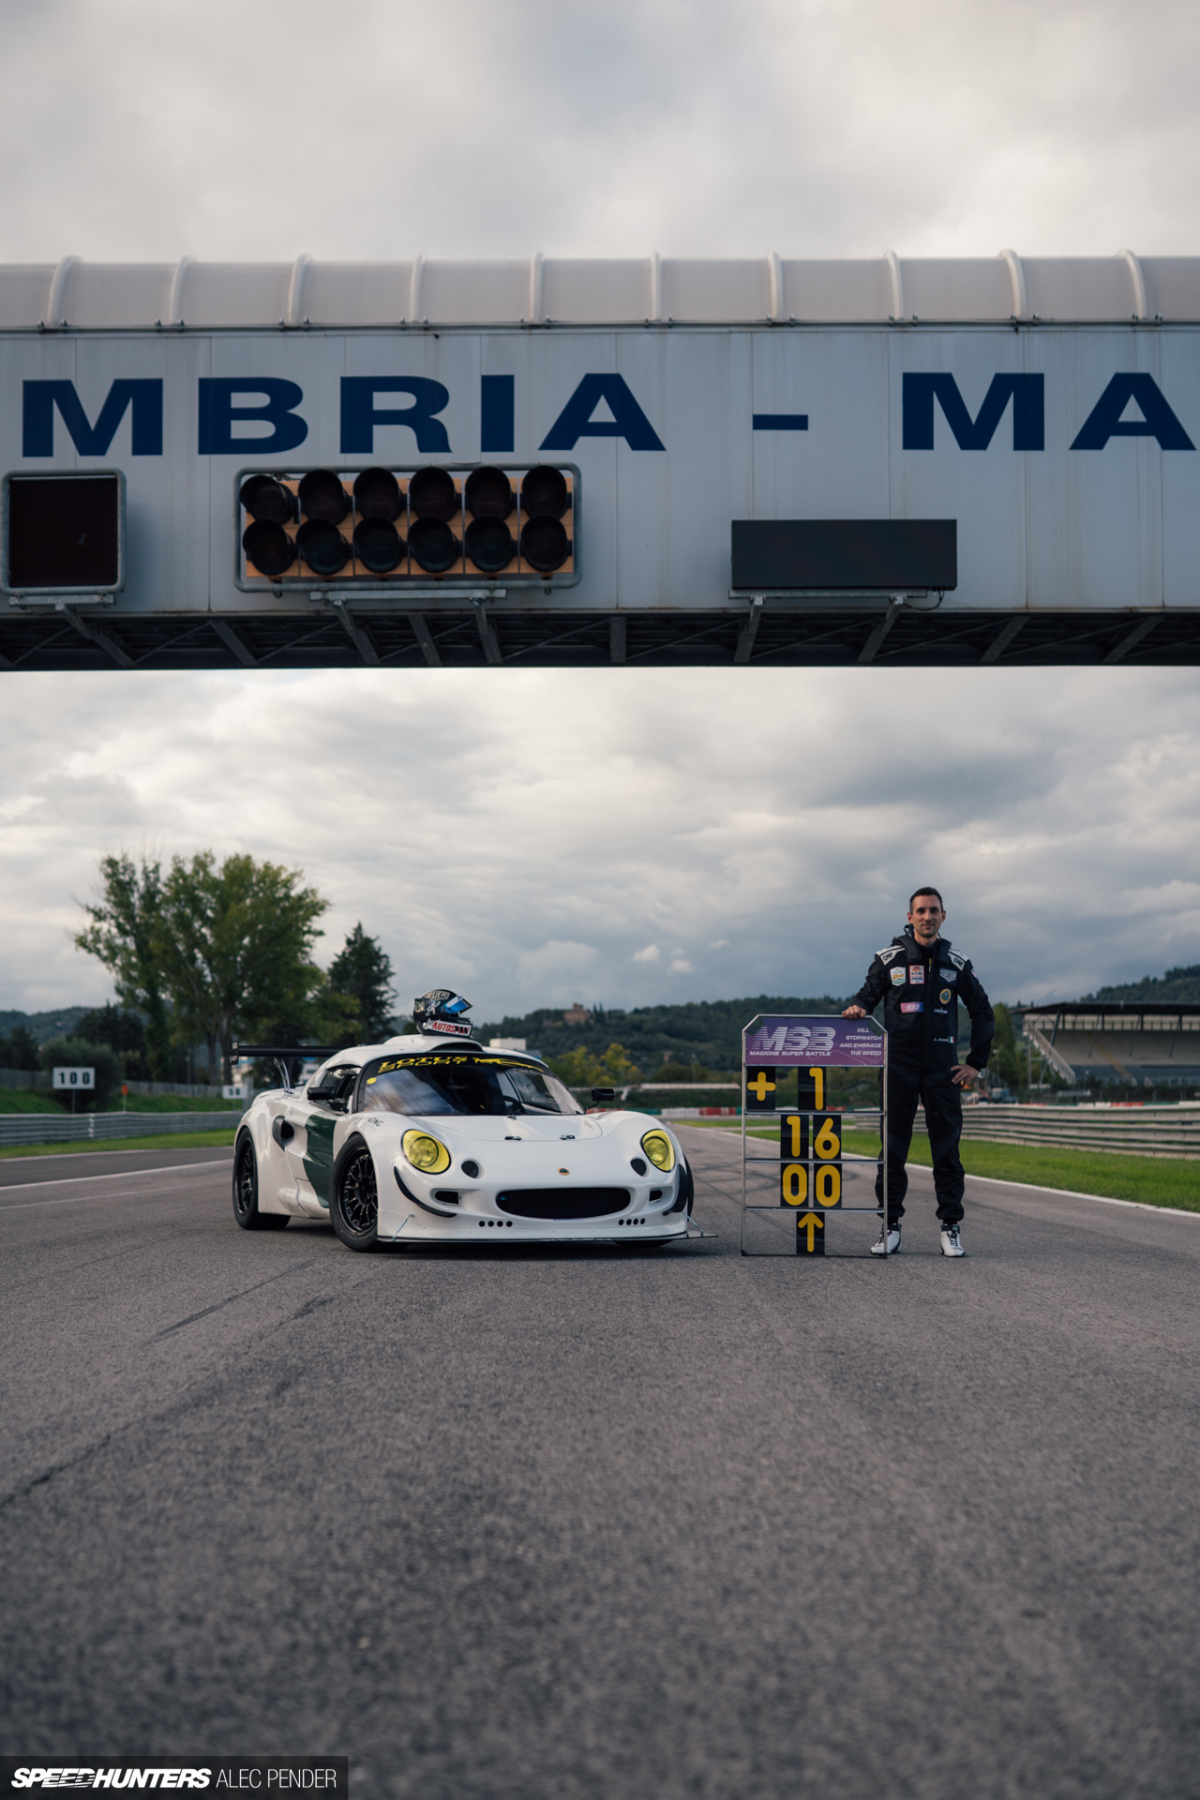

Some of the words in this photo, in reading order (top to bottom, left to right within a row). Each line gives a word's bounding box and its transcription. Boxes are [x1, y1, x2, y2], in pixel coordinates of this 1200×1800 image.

[22, 372, 667, 457] MBRIA
[902, 372, 1197, 451] MA
[751, 1026, 836, 1051] MSB
[58, 1071, 90, 1084] 100
[809, 1067, 823, 1110] 1
[786, 1115, 840, 1160] 16
[782, 1163, 841, 1207] 00
